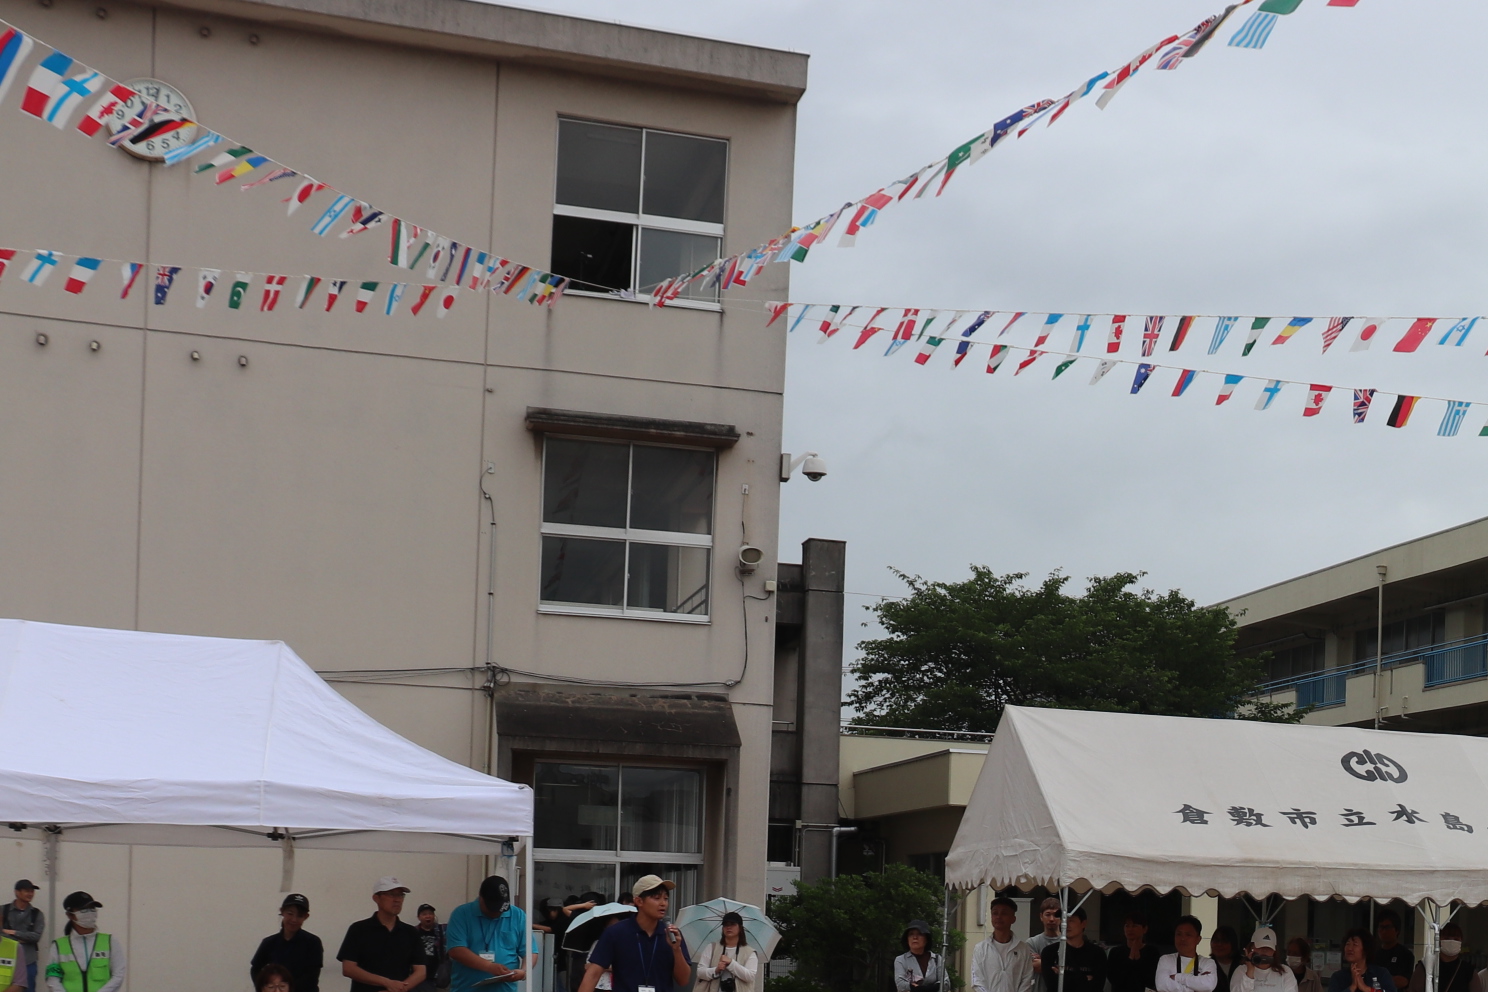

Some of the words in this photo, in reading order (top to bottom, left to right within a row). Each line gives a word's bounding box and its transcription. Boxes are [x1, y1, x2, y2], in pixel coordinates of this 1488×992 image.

[165, 94, 171, 104] 1
[174, 104, 182, 114] 2
[116, 110, 125, 120] 9
[172, 131, 180, 141] 4
[146, 140, 155, 151] 6
[161, 138, 170, 149] 5
